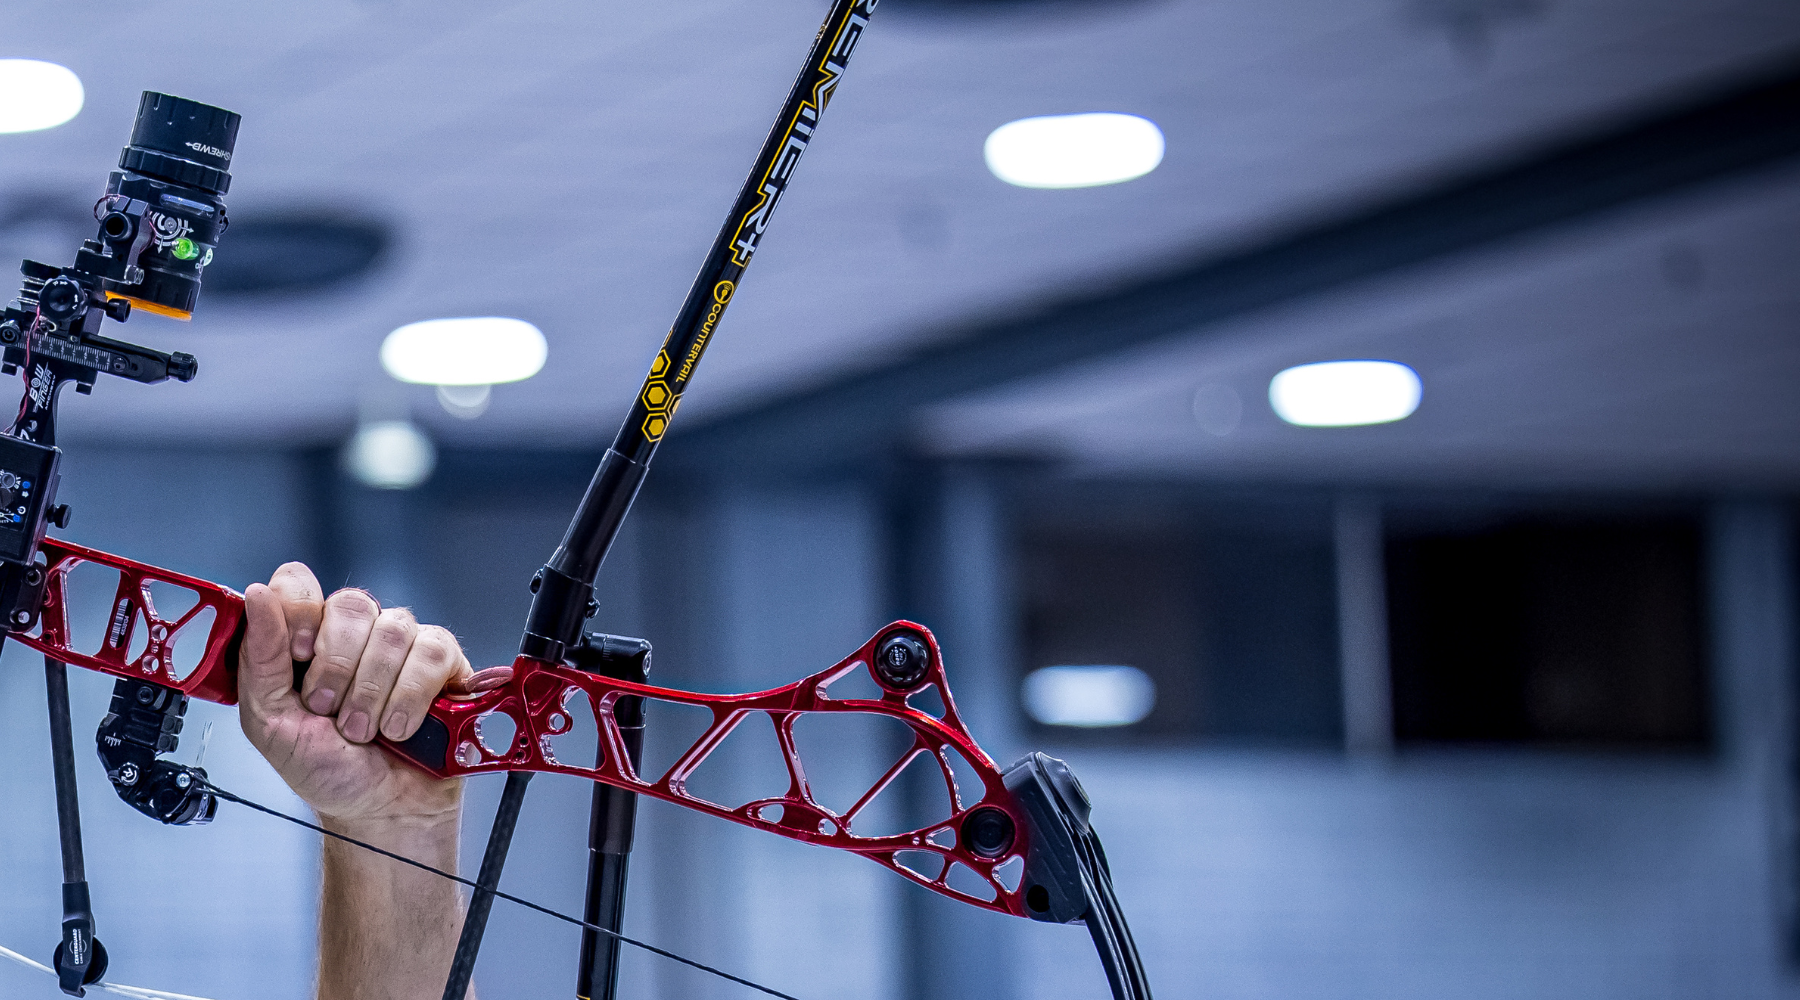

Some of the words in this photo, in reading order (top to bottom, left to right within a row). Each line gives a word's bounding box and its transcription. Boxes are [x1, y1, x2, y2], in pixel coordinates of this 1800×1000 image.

[191, 142, 232, 161] SHREWD
[737, 0, 878, 261] EMIER+
[675, 303, 722, 383] COUNTERVAIL
